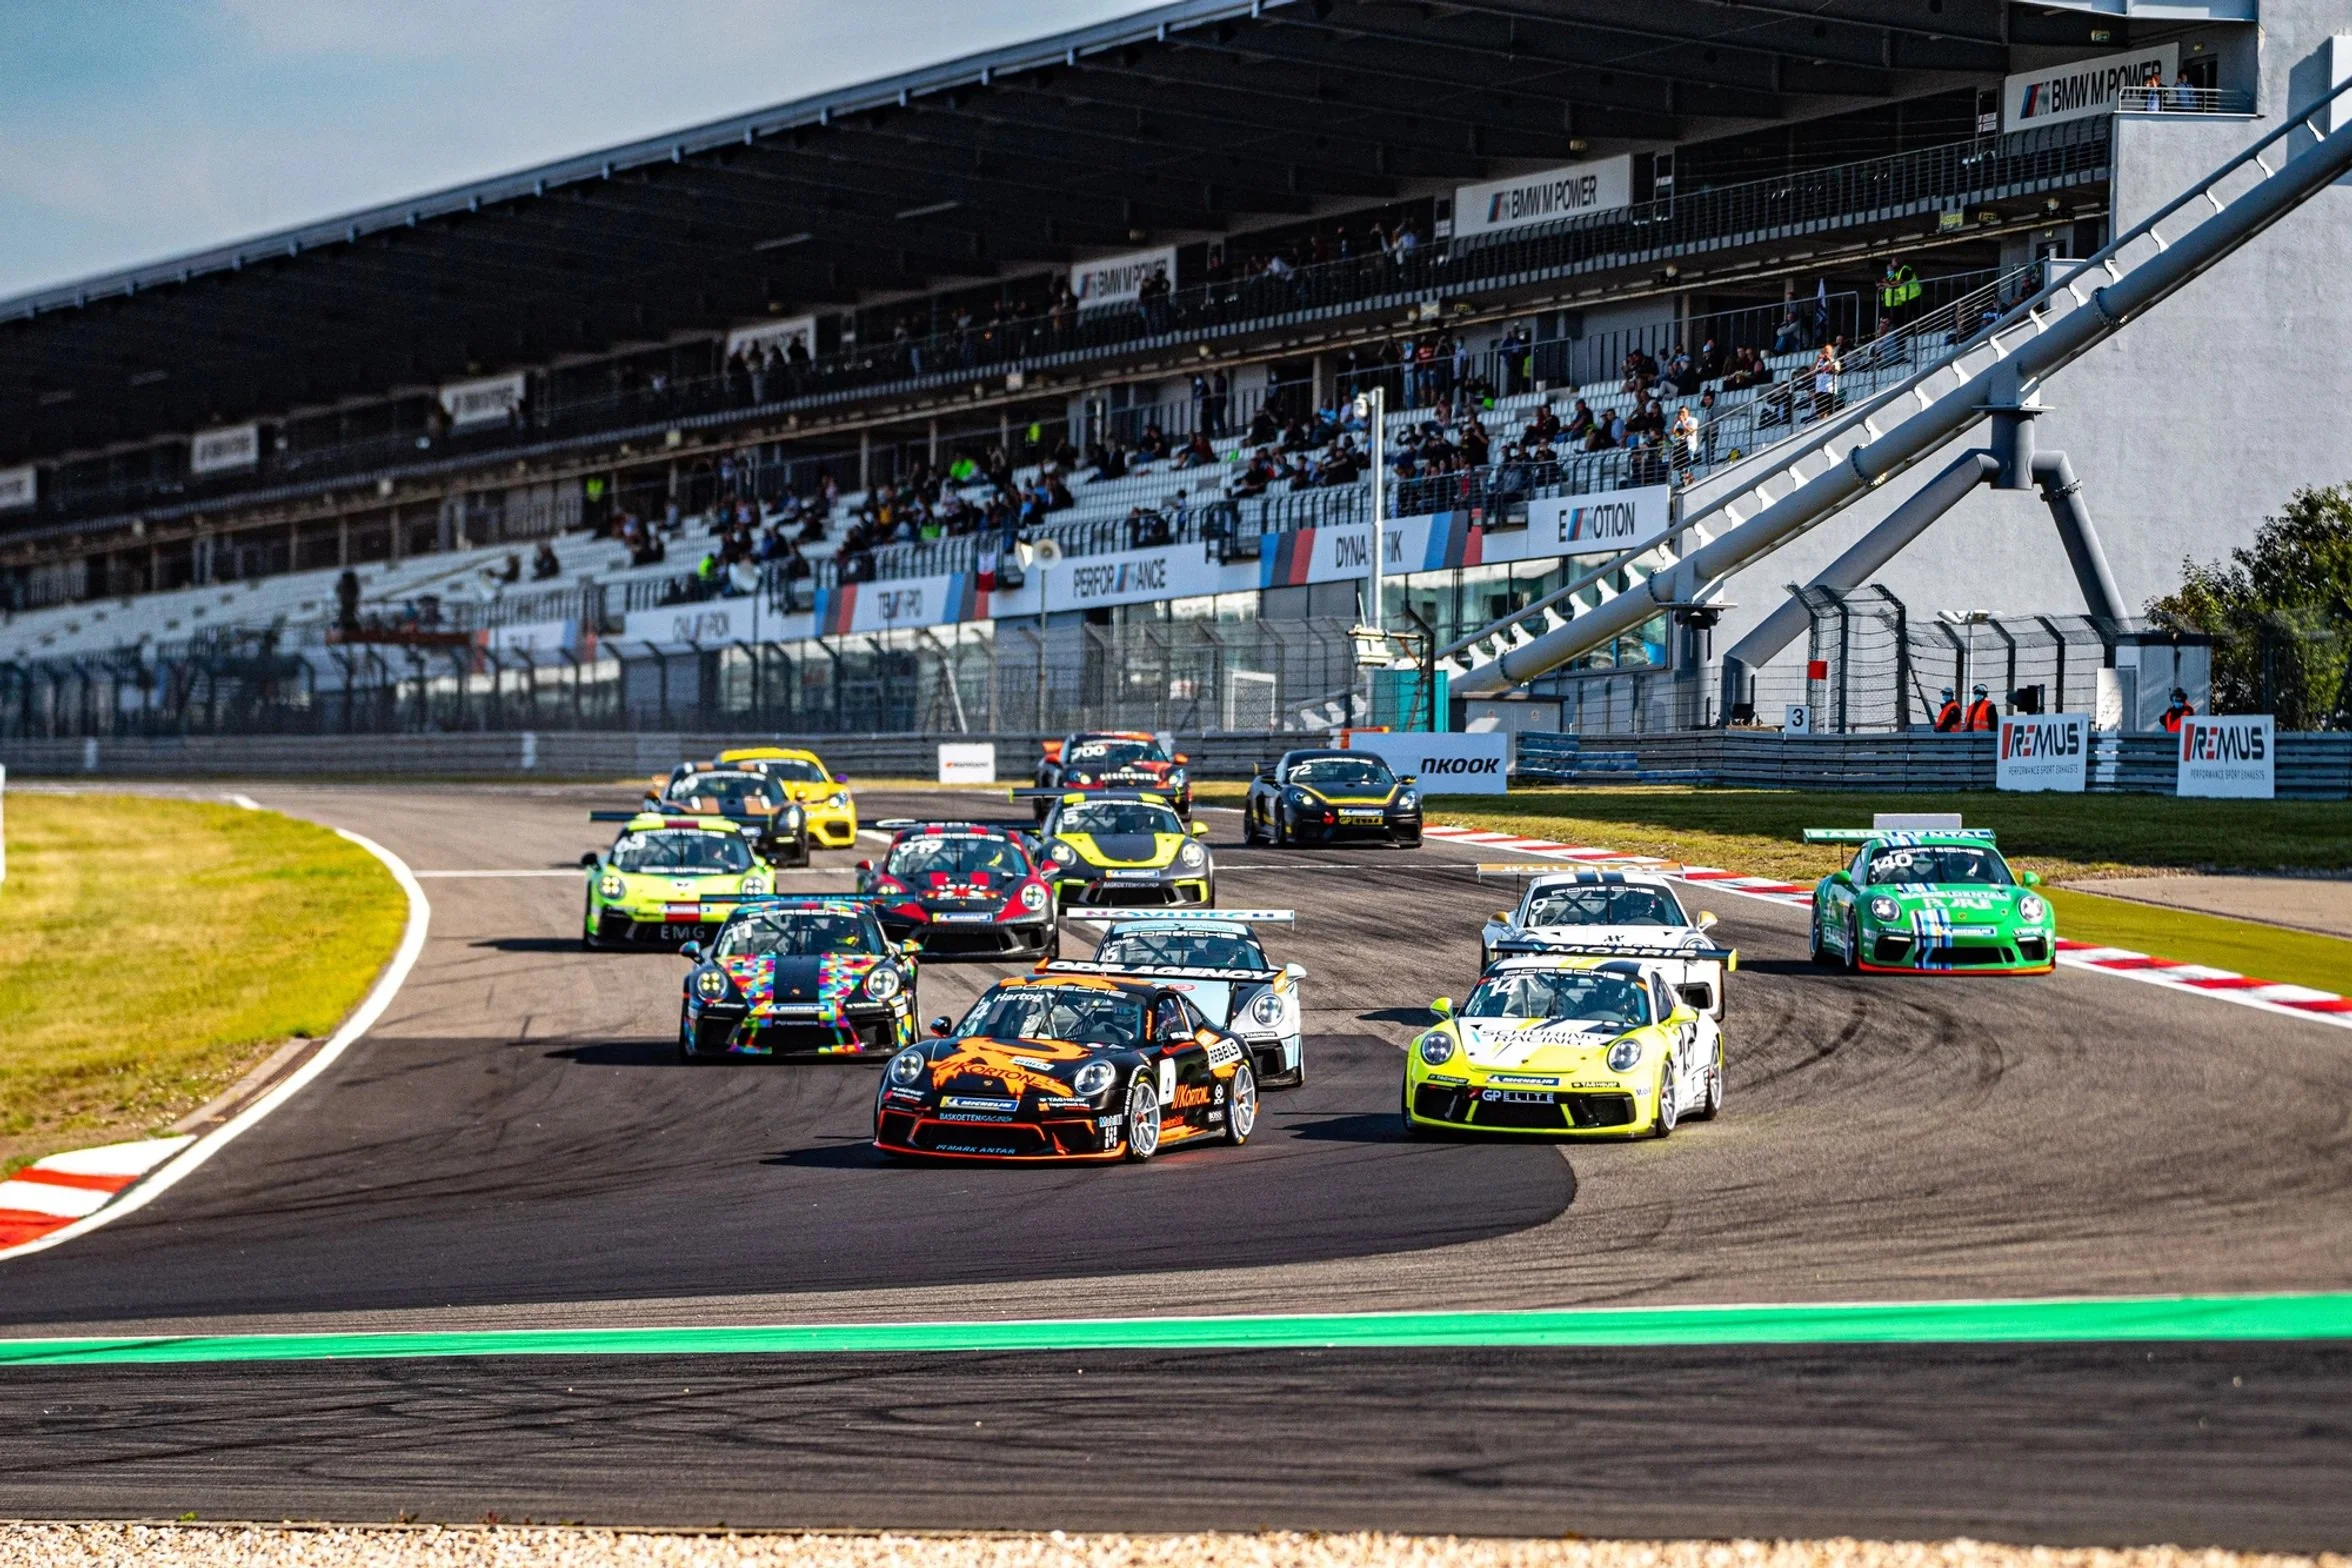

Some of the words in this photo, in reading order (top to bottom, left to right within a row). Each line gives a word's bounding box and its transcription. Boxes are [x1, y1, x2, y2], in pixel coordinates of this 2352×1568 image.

[2052, 72, 2090, 113] BMW
[2090, 69, 2106, 106] M
[1511, 186, 1542, 219] BMW
[1542, 183, 1555, 214] M
[1555, 175, 1597, 211] POWER
[1335, 530, 1403, 569] DYNAIK
[1791, 707, 1804, 727] 3
[2009, 722, 2080, 761] REMUS
[2191, 725, 2265, 765] REMUS
[1070, 745, 1107, 761] 700
[1288, 765, 1312, 780] 72
[1868, 854, 1913, 873] 140
[1530, 899, 1549, 915] 9
[1546, 945, 1698, 957] MORRIS
[1502, 968, 1626, 981] PORSCHE
[1004, 984, 1129, 999] PORSCHE
[1486, 977, 1519, 998] 14
[993, 991, 1044, 1002] Hartog
[1493, 1035, 1582, 1046] RACING
[1208, 1041, 1239, 1063] REBELS
[1503, 1077, 1555, 1085] MICHELIN
[960, 1100, 1013, 1108] MICHELIN
[1482, 1090, 1500, 1102] GP
[1502, 1091, 1555, 1101] ELITE
